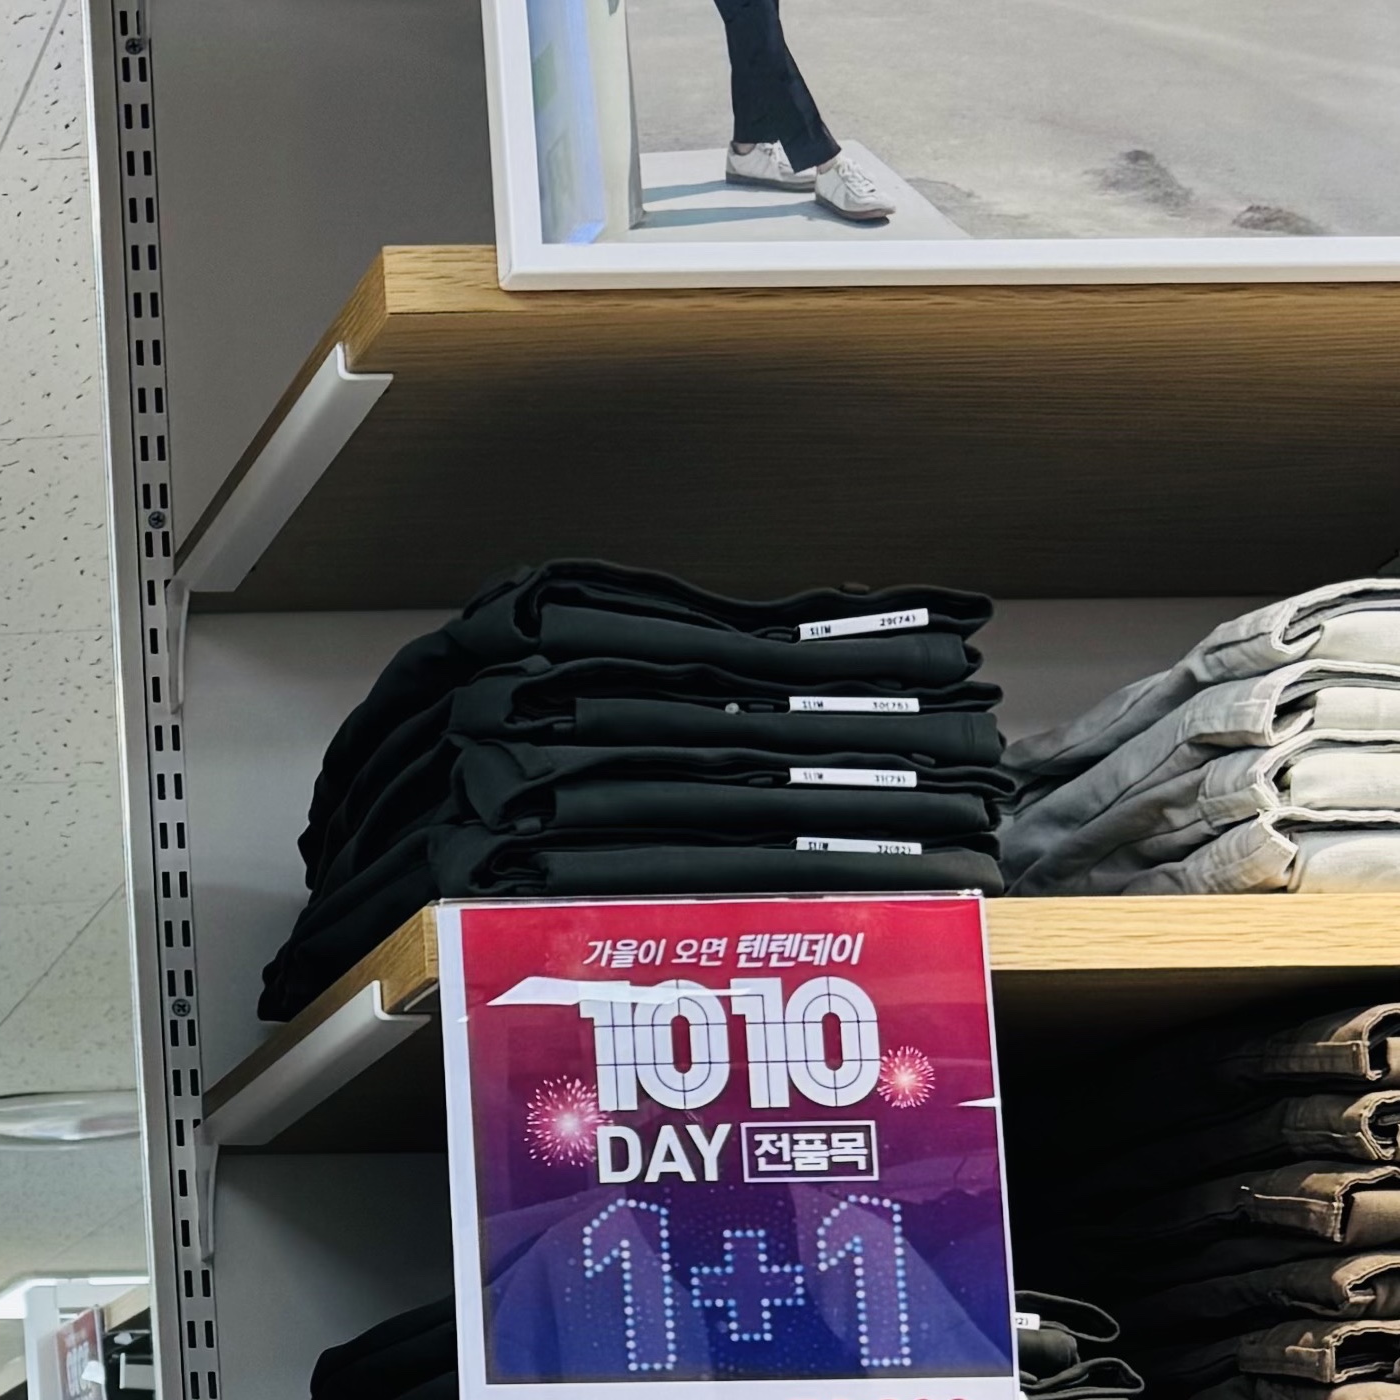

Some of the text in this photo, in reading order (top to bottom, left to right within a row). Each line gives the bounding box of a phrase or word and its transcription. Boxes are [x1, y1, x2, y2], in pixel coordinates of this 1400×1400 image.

[583, 932, 865, 969] 가을이 오면 텐텐데이
[597, 1124, 869, 1183] DAY 전품목
[583, 1196, 914, 1372] 1+1
